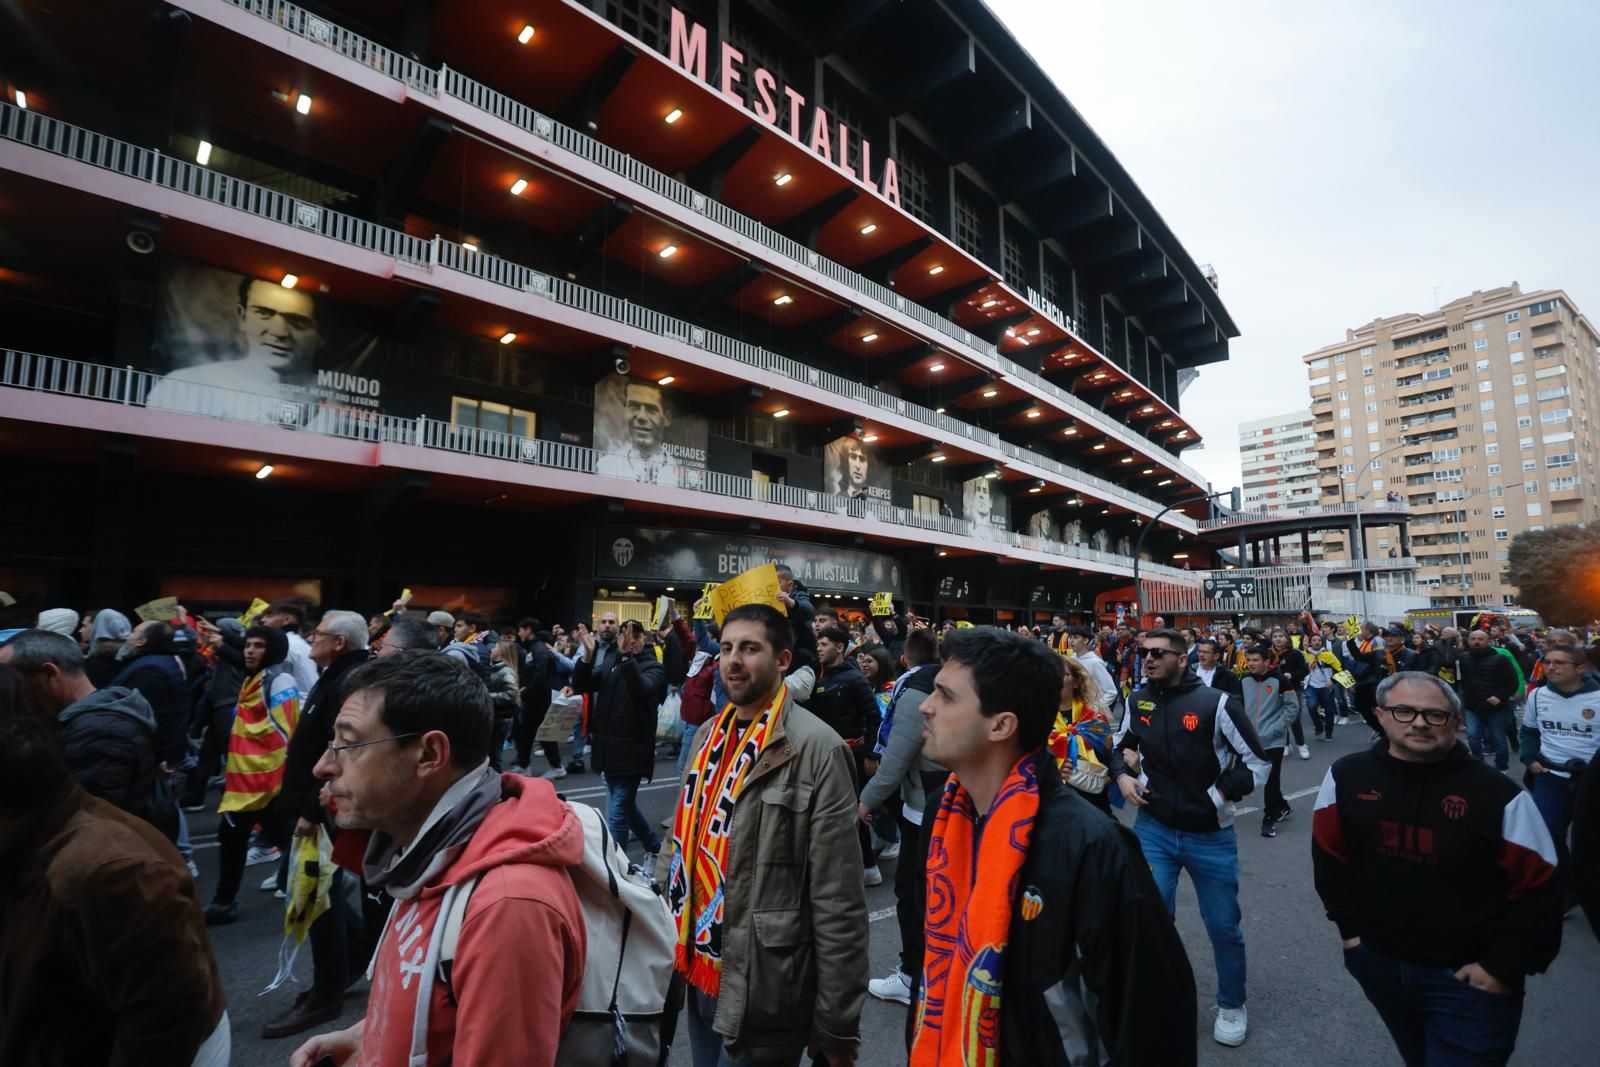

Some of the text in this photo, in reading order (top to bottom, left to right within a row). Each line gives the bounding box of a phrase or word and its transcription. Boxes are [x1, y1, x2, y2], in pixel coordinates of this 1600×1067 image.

[670, 6, 901, 208] MESTALLA
[1027, 285, 1064, 327] VALENCIA
[317, 369, 380, 396] MUNDO
[351, 395, 380, 407] LEGEND
[868, 485, 891, 500] KEMPES
[805, 562, 812, 579] A
[815, 563, 860, 584] MESTALLA
[1240, 583, 1254, 594] 52
